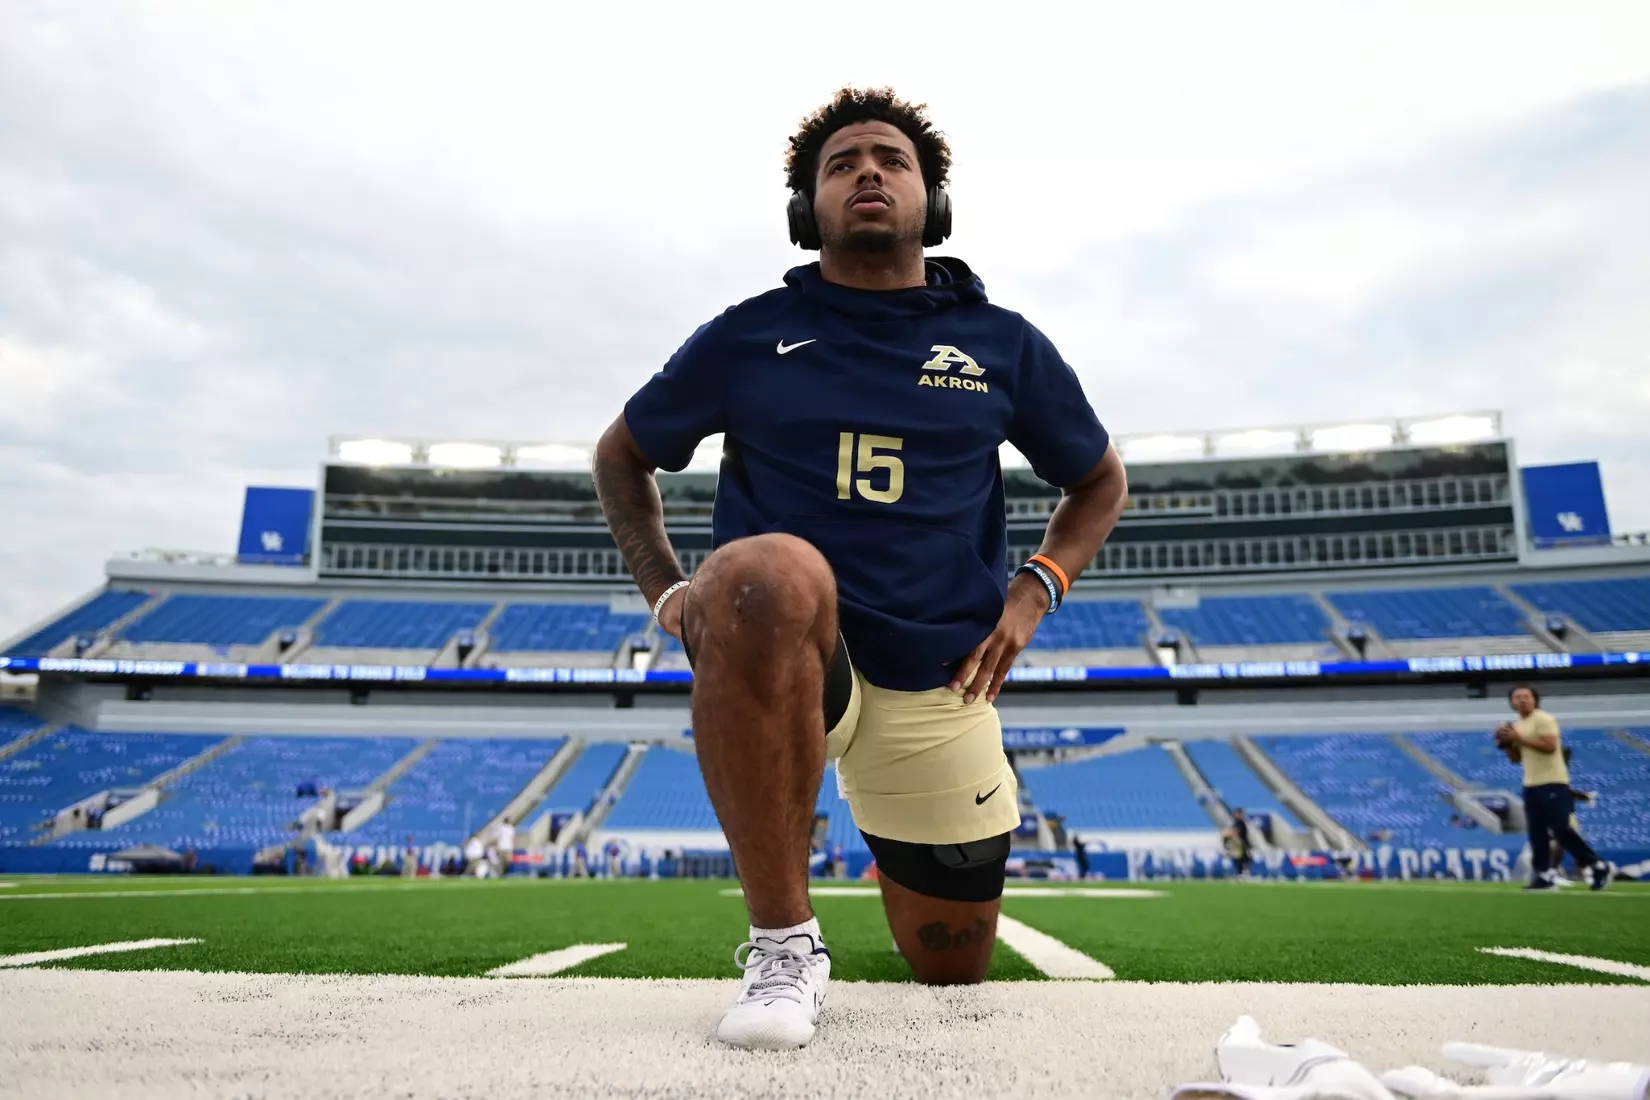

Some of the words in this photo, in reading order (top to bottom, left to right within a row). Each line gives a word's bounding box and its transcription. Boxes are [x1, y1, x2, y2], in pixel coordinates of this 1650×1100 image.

[921, 344, 986, 377] A
[917, 374, 989, 394] AKRON
[836, 431, 905, 504] 15
